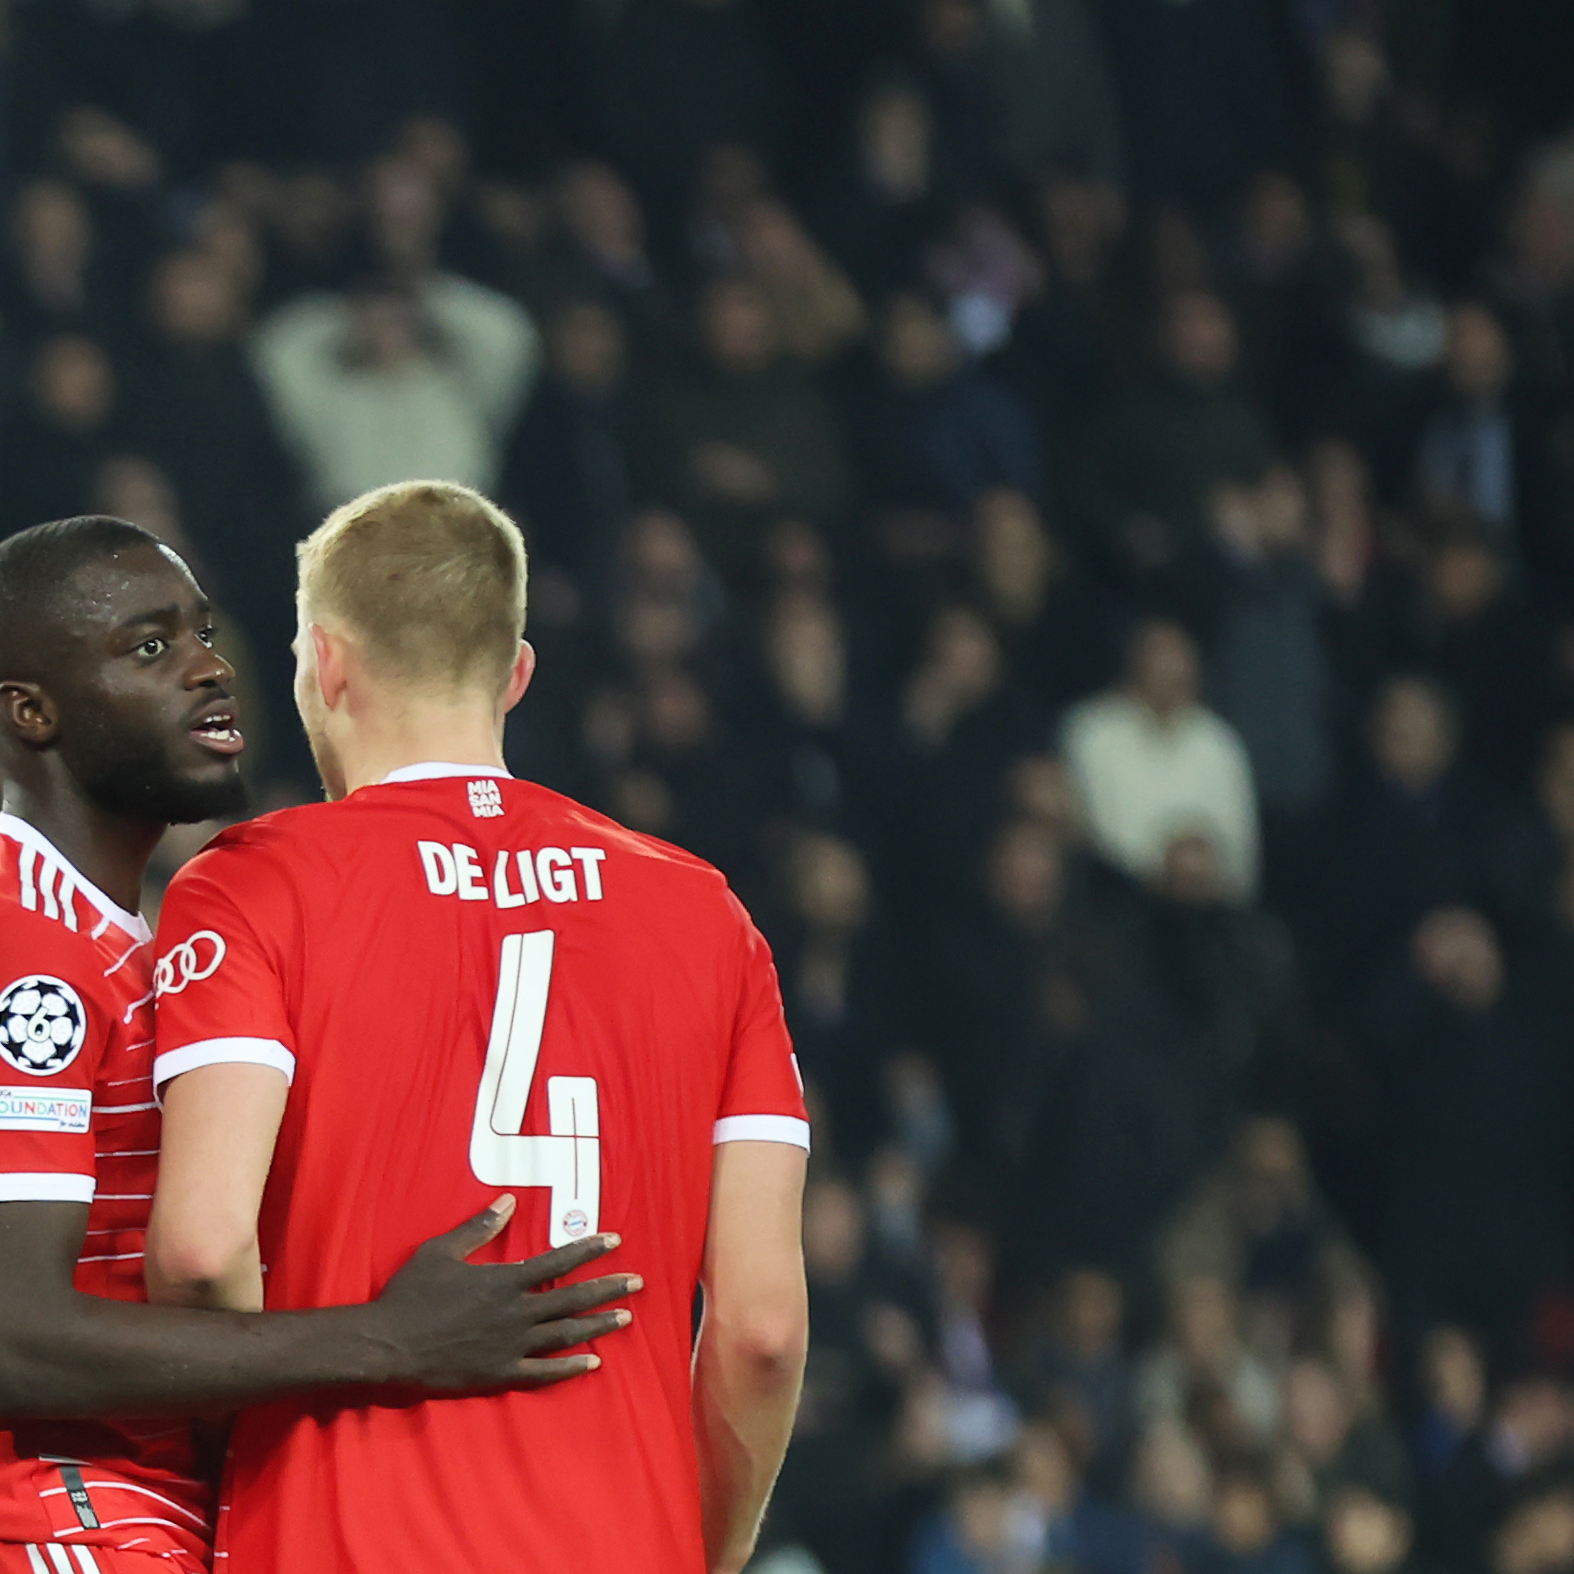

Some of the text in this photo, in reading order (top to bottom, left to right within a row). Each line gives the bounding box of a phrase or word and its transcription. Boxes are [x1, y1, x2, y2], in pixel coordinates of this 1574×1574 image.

[467, 779, 499, 796] MIA
[468, 792, 502, 807] SAN
[472, 804, 506, 818] MIA
[418, 840, 606, 909] DE LIGT
[27, 1005, 51, 1043] 6
[469, 929, 600, 1249] 4
